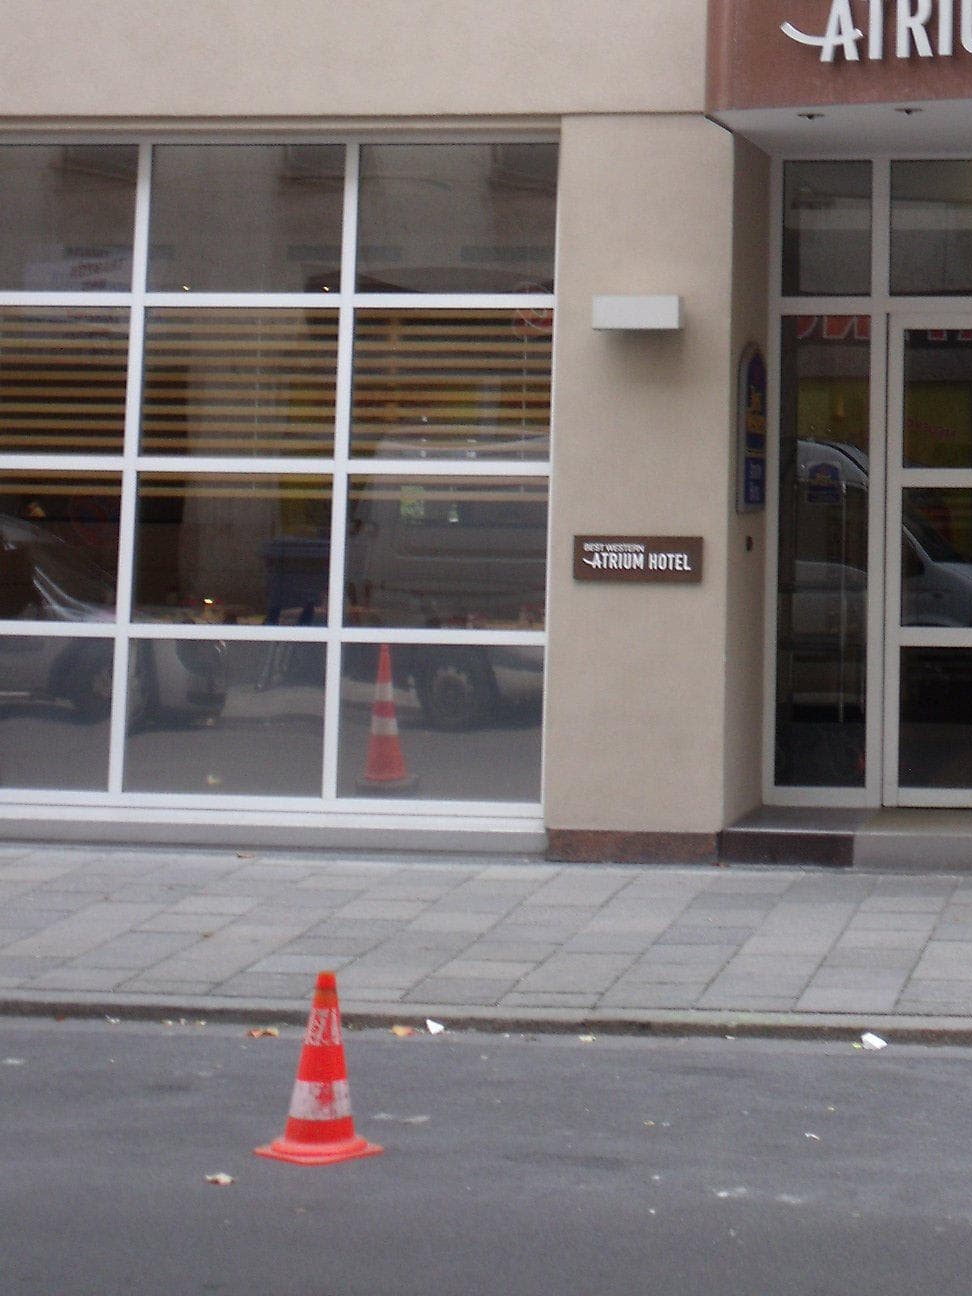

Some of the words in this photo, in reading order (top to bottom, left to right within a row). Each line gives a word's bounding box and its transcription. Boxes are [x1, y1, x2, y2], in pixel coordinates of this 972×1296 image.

[583, 543, 604, 552] BEST
[606, 543, 646, 553] WESTERN
[583, 553, 644, 570] ATRIUM
[648, 552, 692, 571] HOTEL
